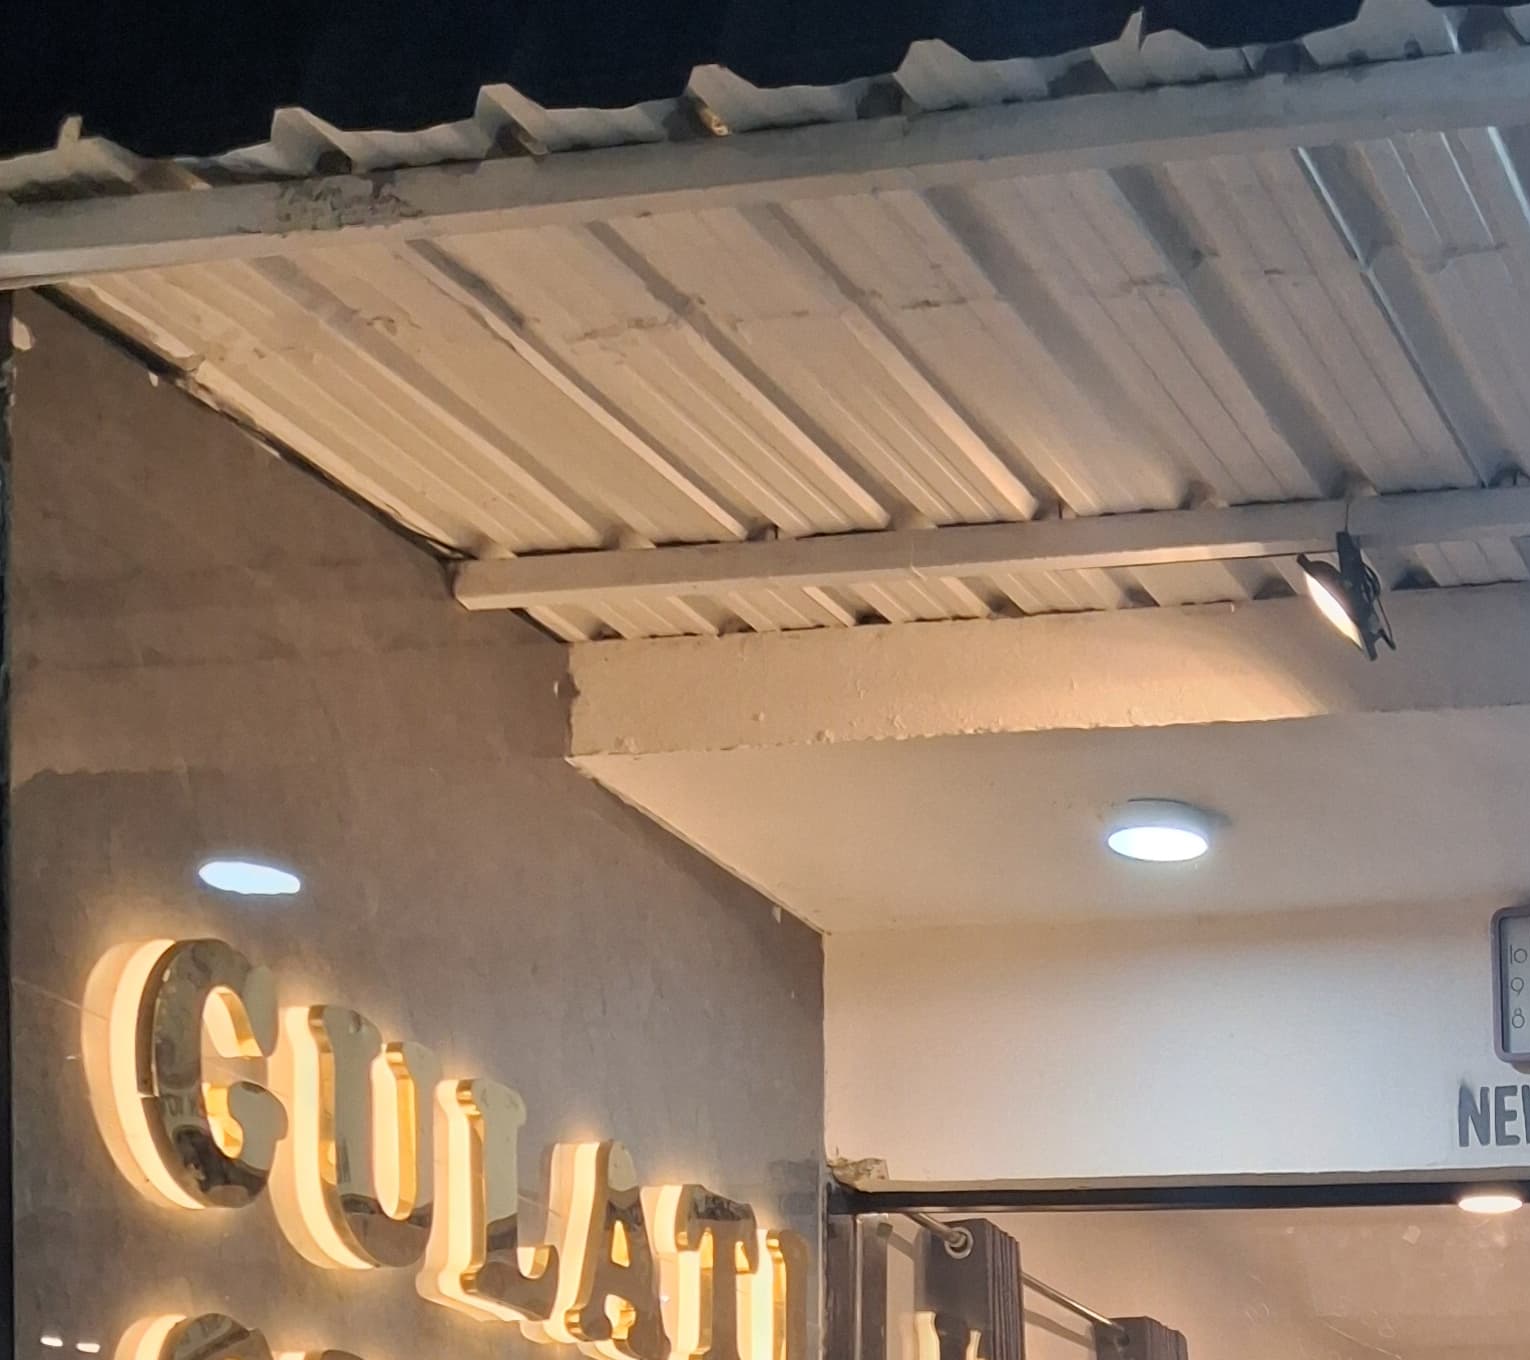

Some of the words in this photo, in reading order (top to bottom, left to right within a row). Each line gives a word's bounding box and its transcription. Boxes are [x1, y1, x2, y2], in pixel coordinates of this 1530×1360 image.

[1510, 945, 1528, 964] 10
[1511, 977, 1524, 997] 9
[1512, 1008, 1525, 1028] 8
